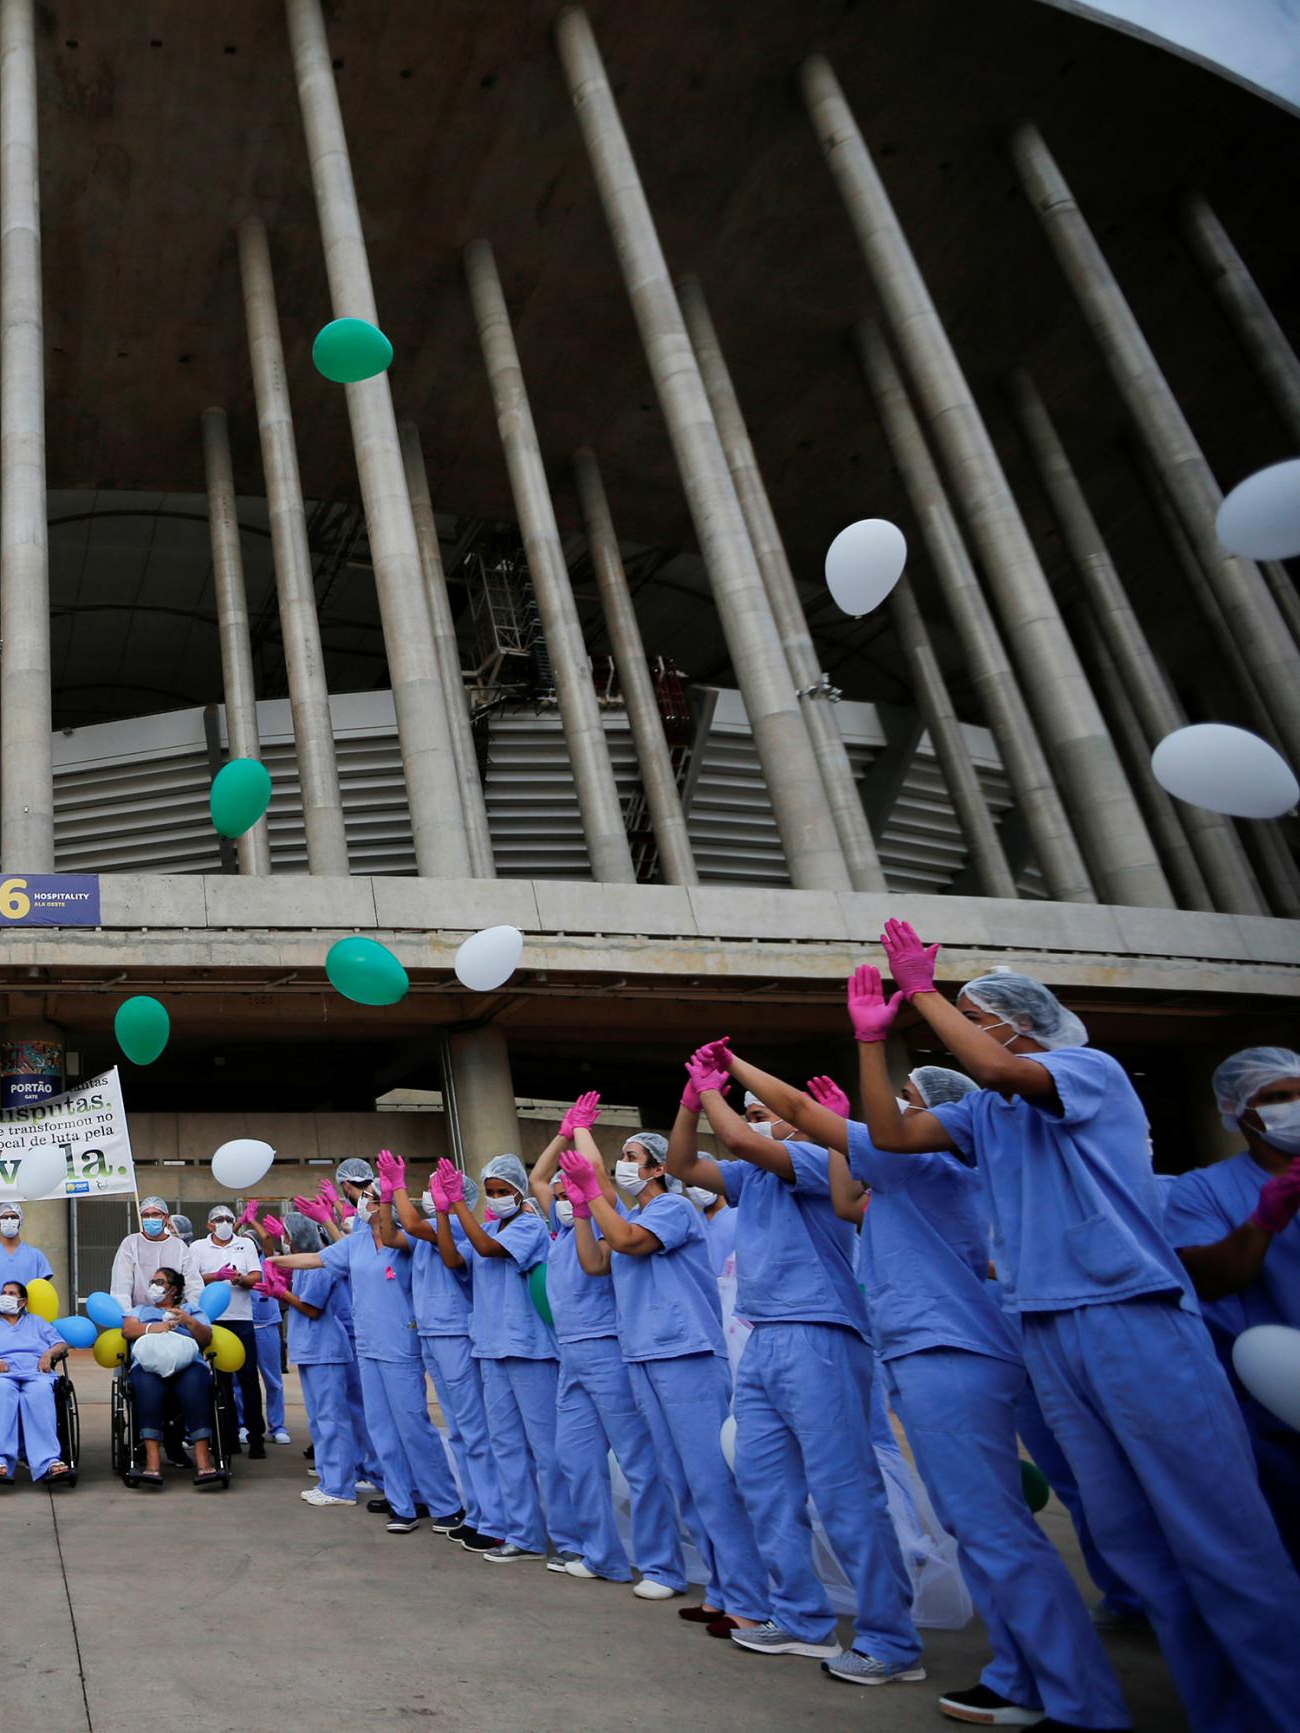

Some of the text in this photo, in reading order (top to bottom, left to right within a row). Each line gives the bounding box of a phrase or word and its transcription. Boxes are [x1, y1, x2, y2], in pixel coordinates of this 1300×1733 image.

[10, 1081, 53, 1094] PORTÃO
[9, 1117, 92, 1135] transformou
[96, 1113, 114, 1123] no
[30, 1135, 47, 1147] de
[51, 1131, 80, 1144] luta
[85, 1126, 115, 1141] pela
